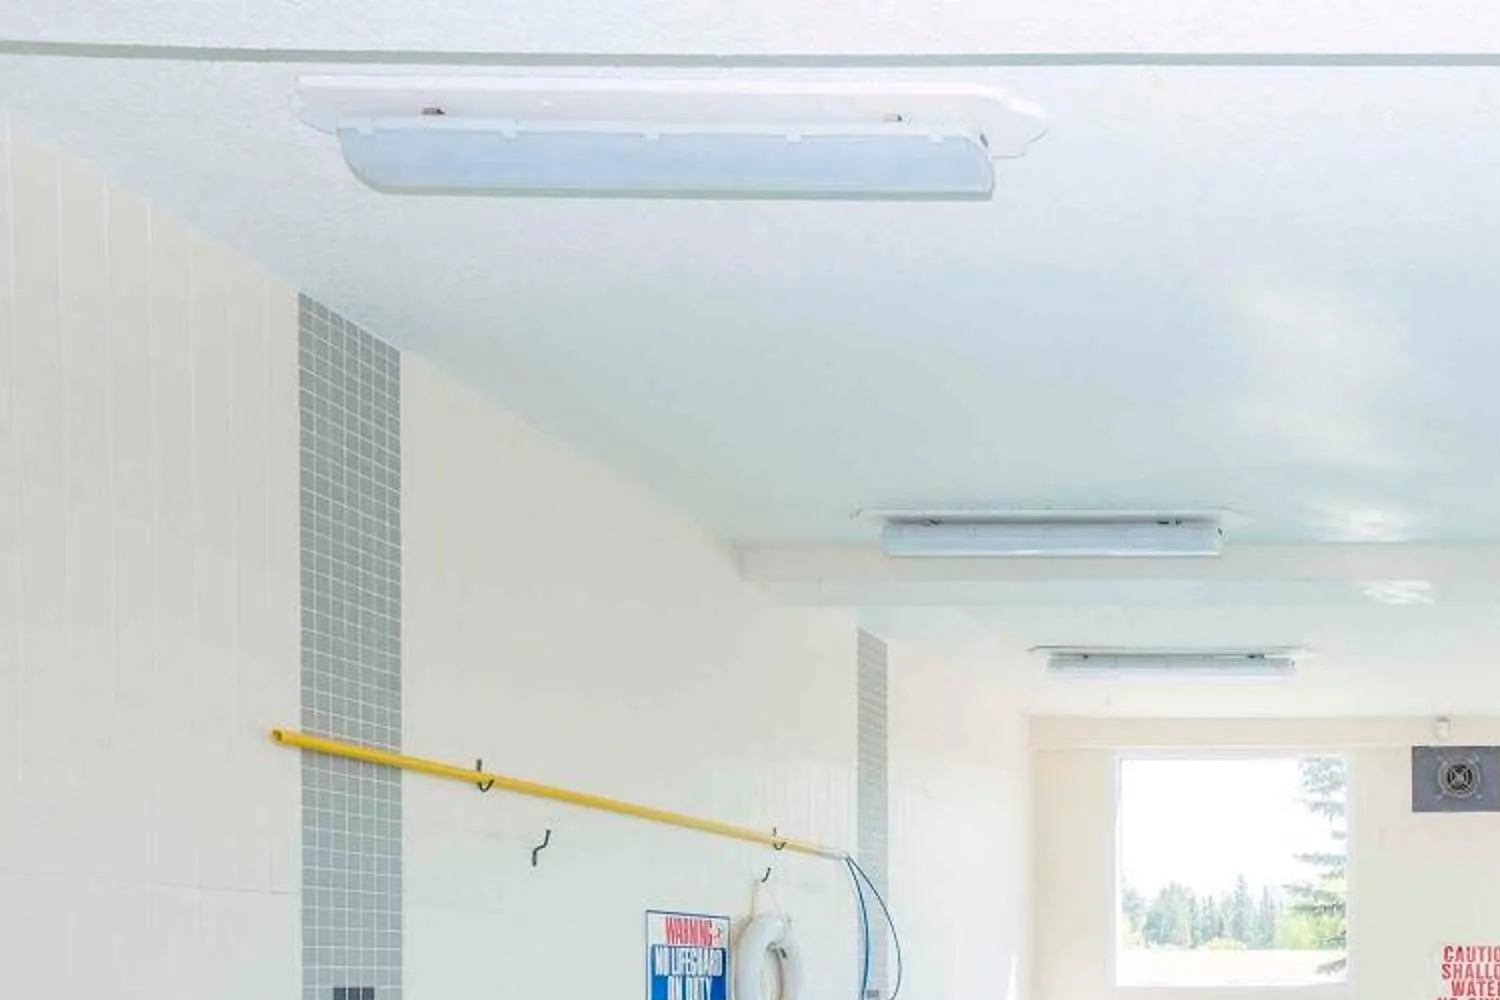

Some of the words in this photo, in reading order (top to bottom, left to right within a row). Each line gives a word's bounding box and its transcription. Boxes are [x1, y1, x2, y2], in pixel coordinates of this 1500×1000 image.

[665, 917, 713, 946] WARNING
[655, 946, 669, 976] NO
[671, 946, 723, 976] LIFEGUARD
